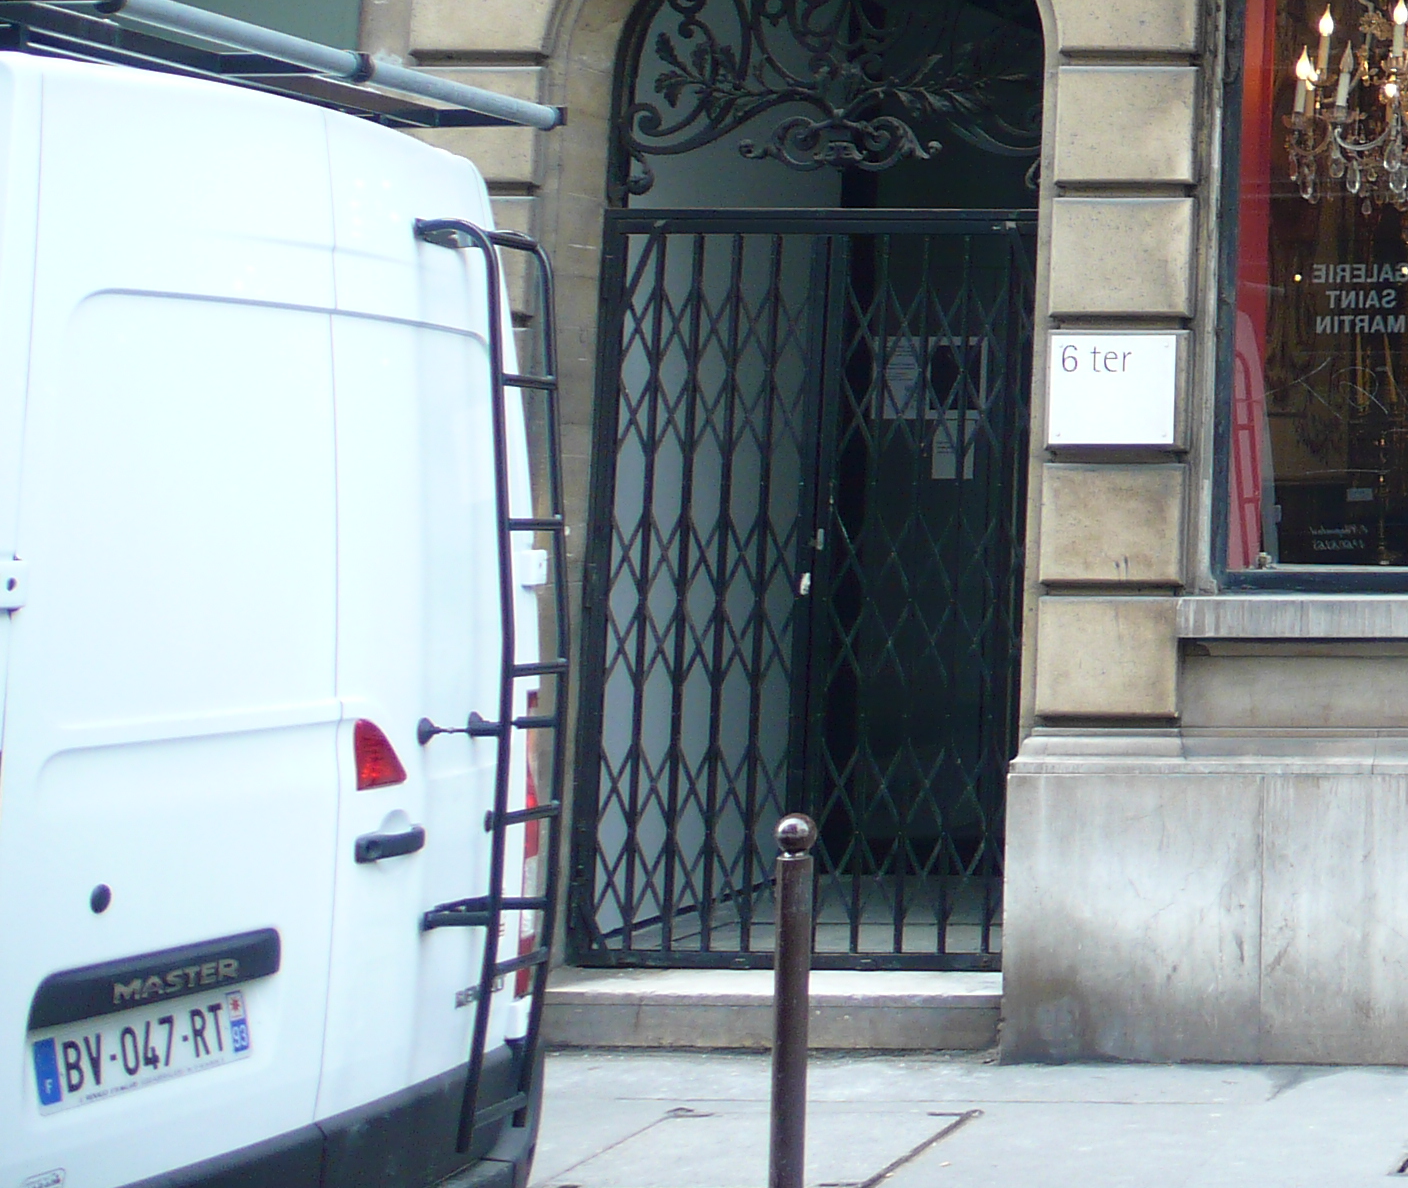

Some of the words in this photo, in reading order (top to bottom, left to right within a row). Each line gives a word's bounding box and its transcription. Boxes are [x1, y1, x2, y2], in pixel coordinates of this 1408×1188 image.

[1062, 344, 1078, 373] 6
[1090, 346, 1132, 373] ter
[112, 958, 239, 1005] MASTER
[62, 1002, 225, 1094] BV-047-RT
[232, 1024, 249, 1048] 93
[44, 1078, 54, 1094] F
